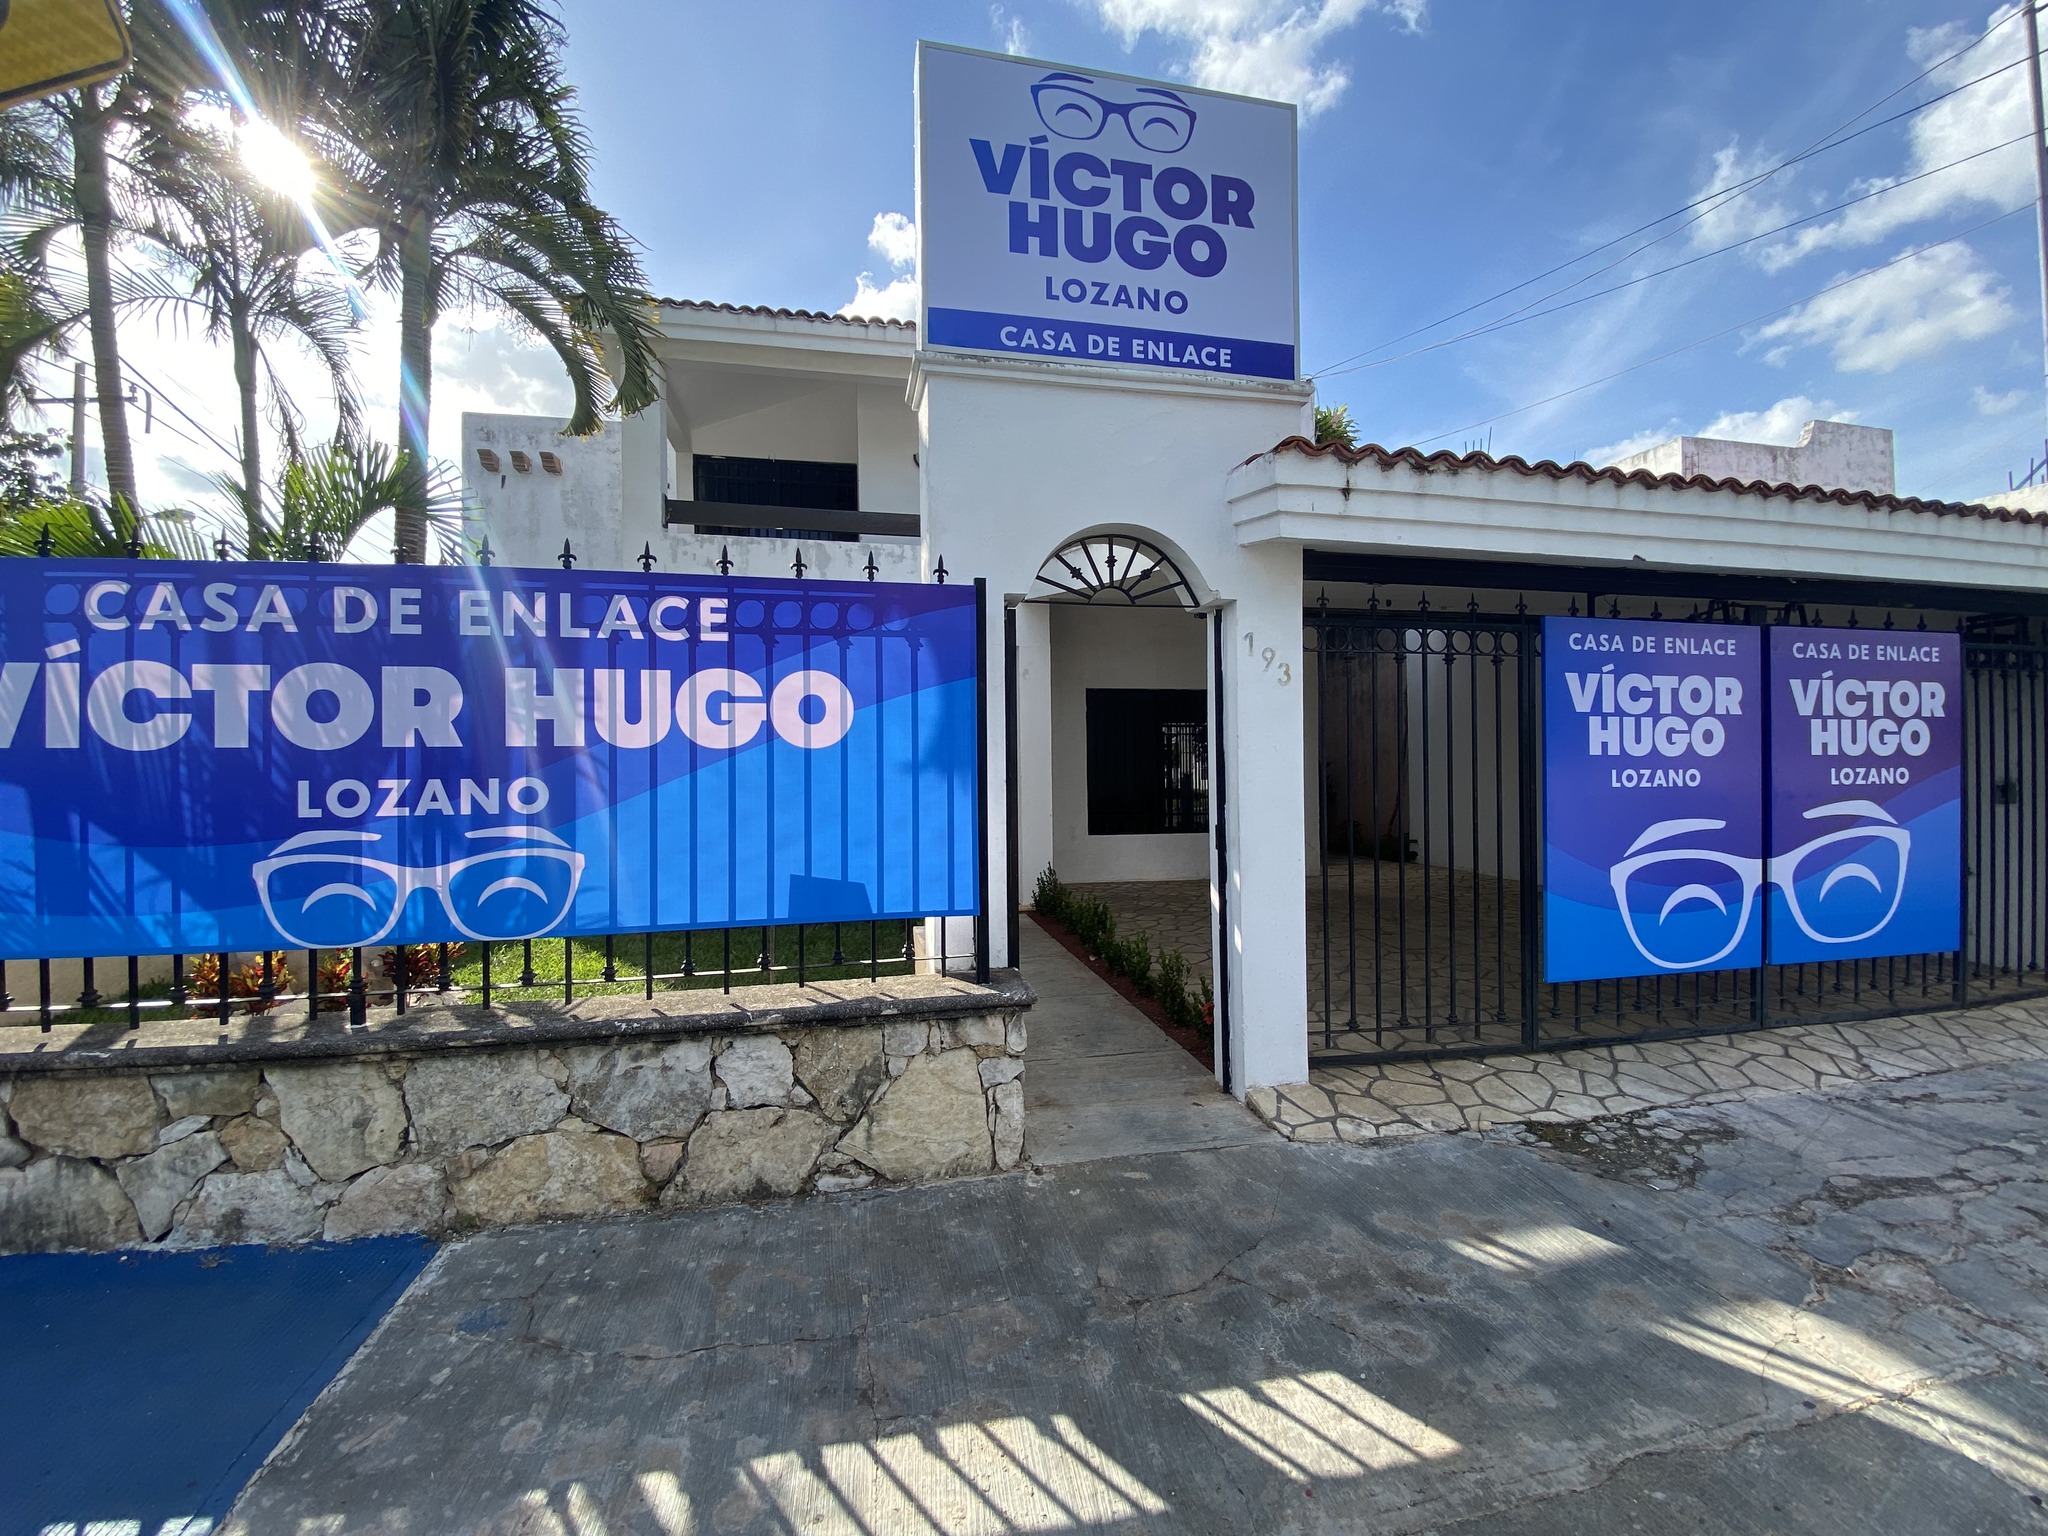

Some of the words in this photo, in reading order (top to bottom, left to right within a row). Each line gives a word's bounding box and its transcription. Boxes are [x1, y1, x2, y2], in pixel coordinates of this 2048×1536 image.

[969, 134, 1255, 229] VÍCTOR
[1008, 201, 1227, 278] HUGO
[1045, 276, 1188, 315] LOZANO
[1000, 326, 1077, 352] CASA
[1087, 334, 1120, 357] DE
[1133, 338, 1232, 368] ENLACE
[84, 580, 299, 633] CASA
[333, 586, 423, 635] DE
[459, 589, 729, 642] ENLACE
[1242, 631, 1291, 686] 193
[1569, 633, 1624, 653] CASA
[1632, 637, 1655, 654] DE
[1664, 637, 1736, 656] ENLACE
[1793, 643, 1842, 660] CASA
[1848, 644, 1870, 660] DE
[1876, 645, 1940, 663] ENLACE
[504, 668, 854, 749] HUGO
[1564, 663, 1743, 716] VÍCTOR
[1789, 670, 1946, 717] VÍCTOR
[1589, 716, 1725, 757] HUGO
[1810, 718, 1931, 757] HUGO
[1611, 768, 1701, 788] LOZANO
[1831, 767, 1910, 785] LOZANO
[298, 777, 549, 818] LOZANO
